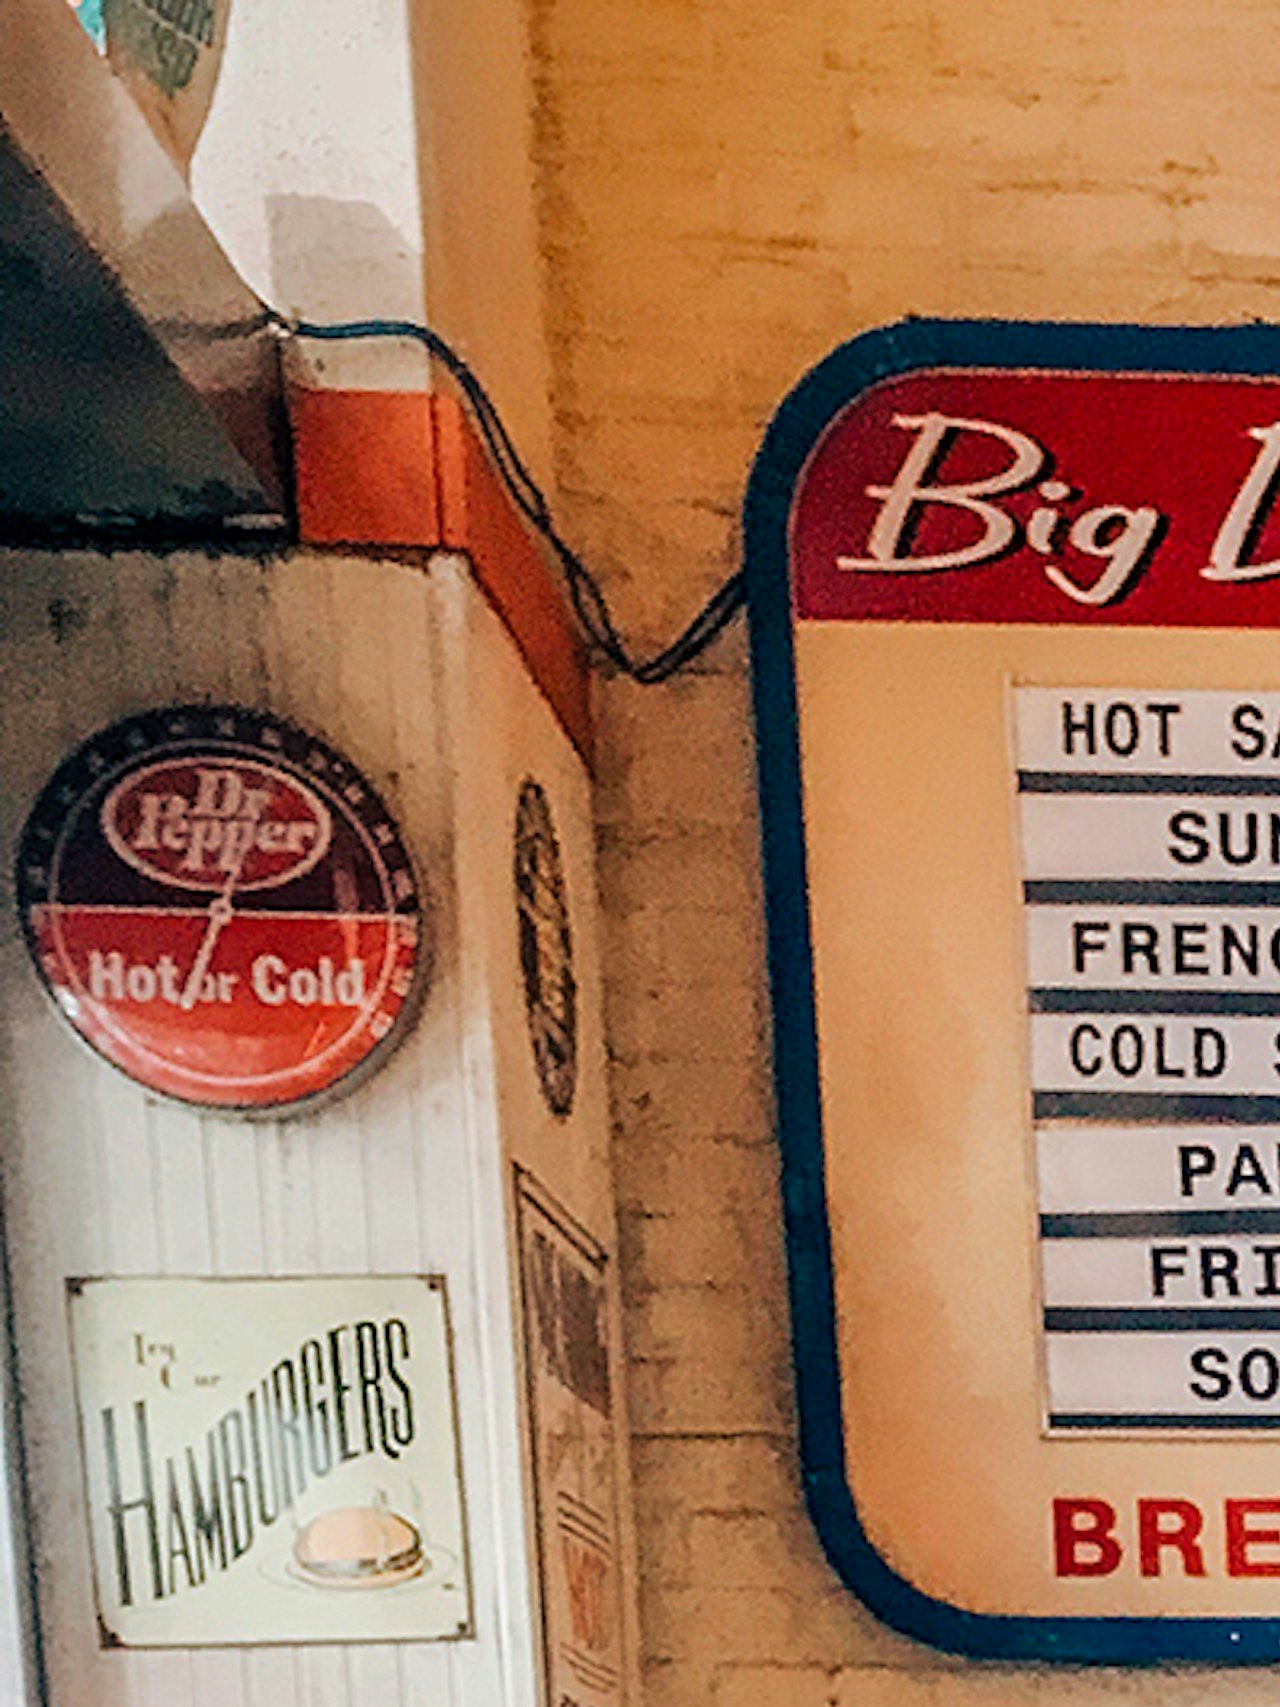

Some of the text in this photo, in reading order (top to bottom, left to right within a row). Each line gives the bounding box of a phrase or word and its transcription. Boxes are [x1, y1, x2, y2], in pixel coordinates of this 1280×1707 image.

[837, 411, 1166, 604] Big
[1063, 702, 1180, 757] HOT
[134, 769, 318, 871] Dr Pepper
[88, 948, 182, 1001] Hot
[250, 953, 366, 1006] Cold
[1070, 1024, 1226, 1077] COLD
[101, 1318, 415, 1607] HAMBURGERS
